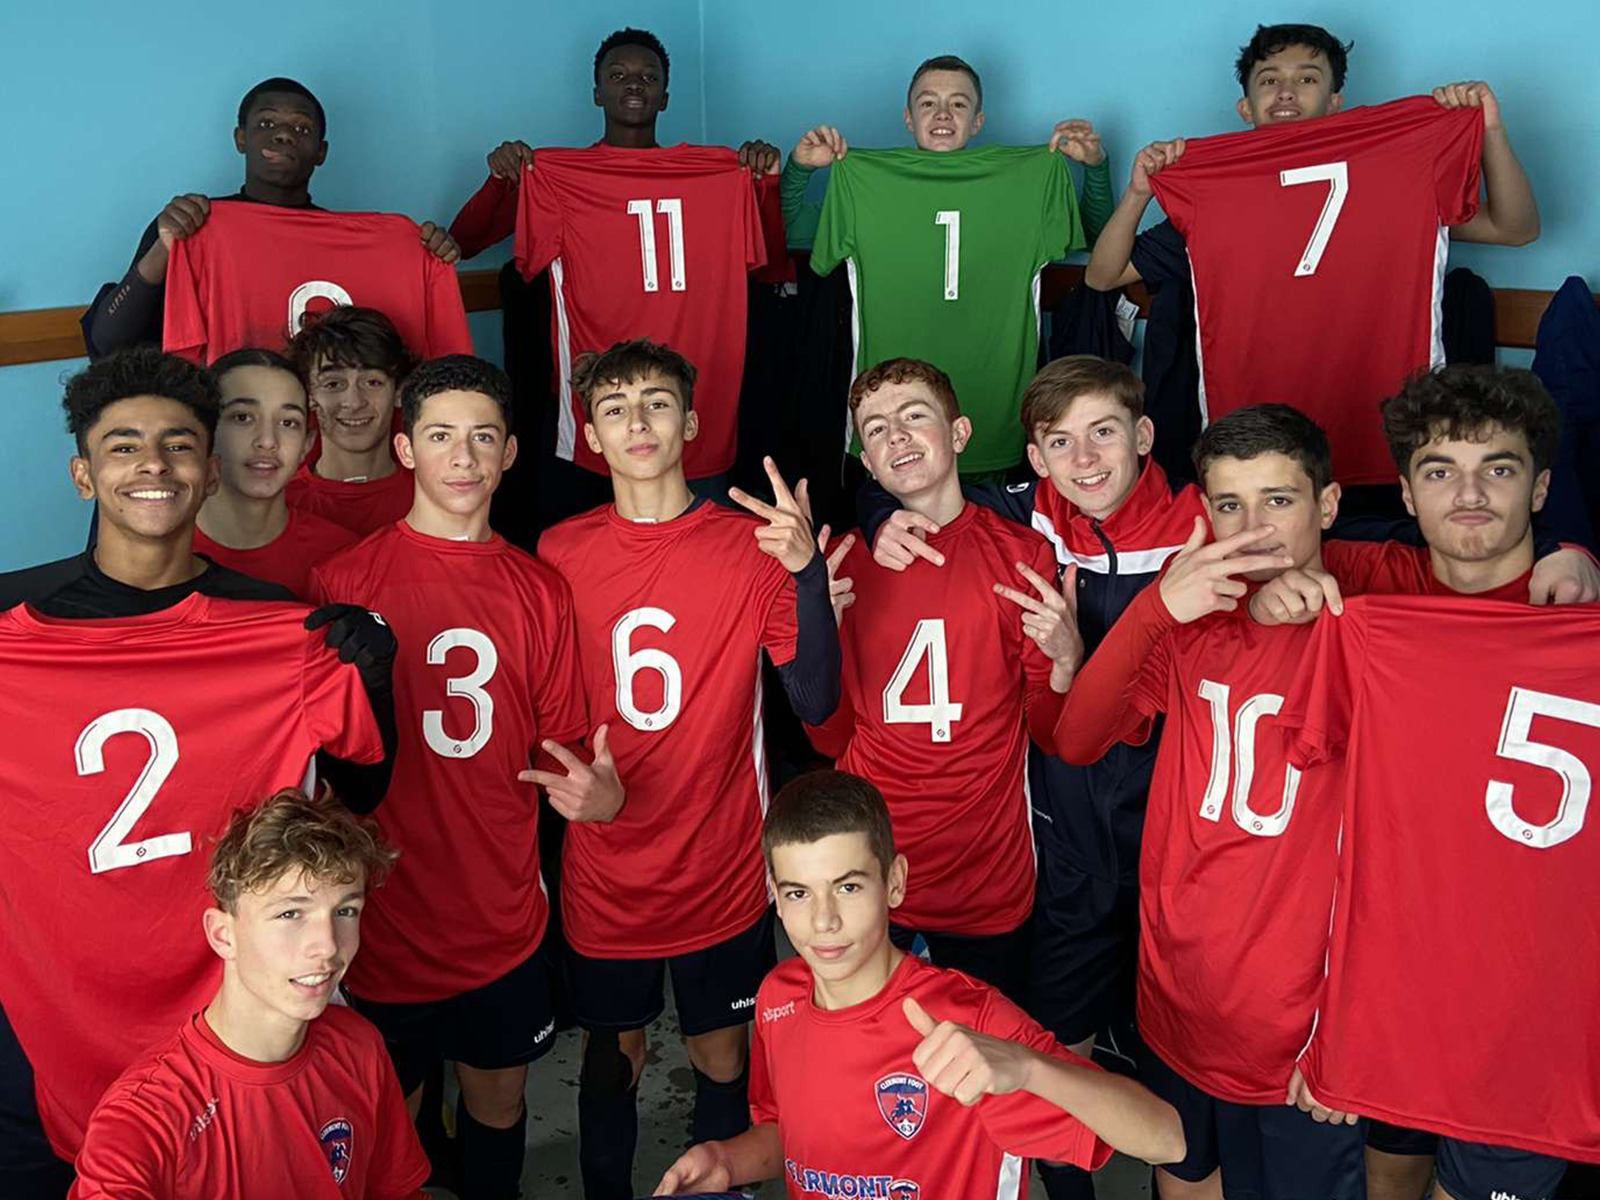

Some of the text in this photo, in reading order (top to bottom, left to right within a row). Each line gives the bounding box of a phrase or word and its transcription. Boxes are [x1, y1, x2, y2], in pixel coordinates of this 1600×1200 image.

[627, 199, 686, 292] 11
[935, 211, 961, 301] 1
[1280, 162, 1349, 277] 7
[422, 628, 498, 759] 3
[612, 607, 682, 732] 6
[882, 619, 963, 742] 4
[74, 708, 192, 874] 2
[1198, 679, 1302, 837] 10
[1485, 686, 1600, 848] 5
